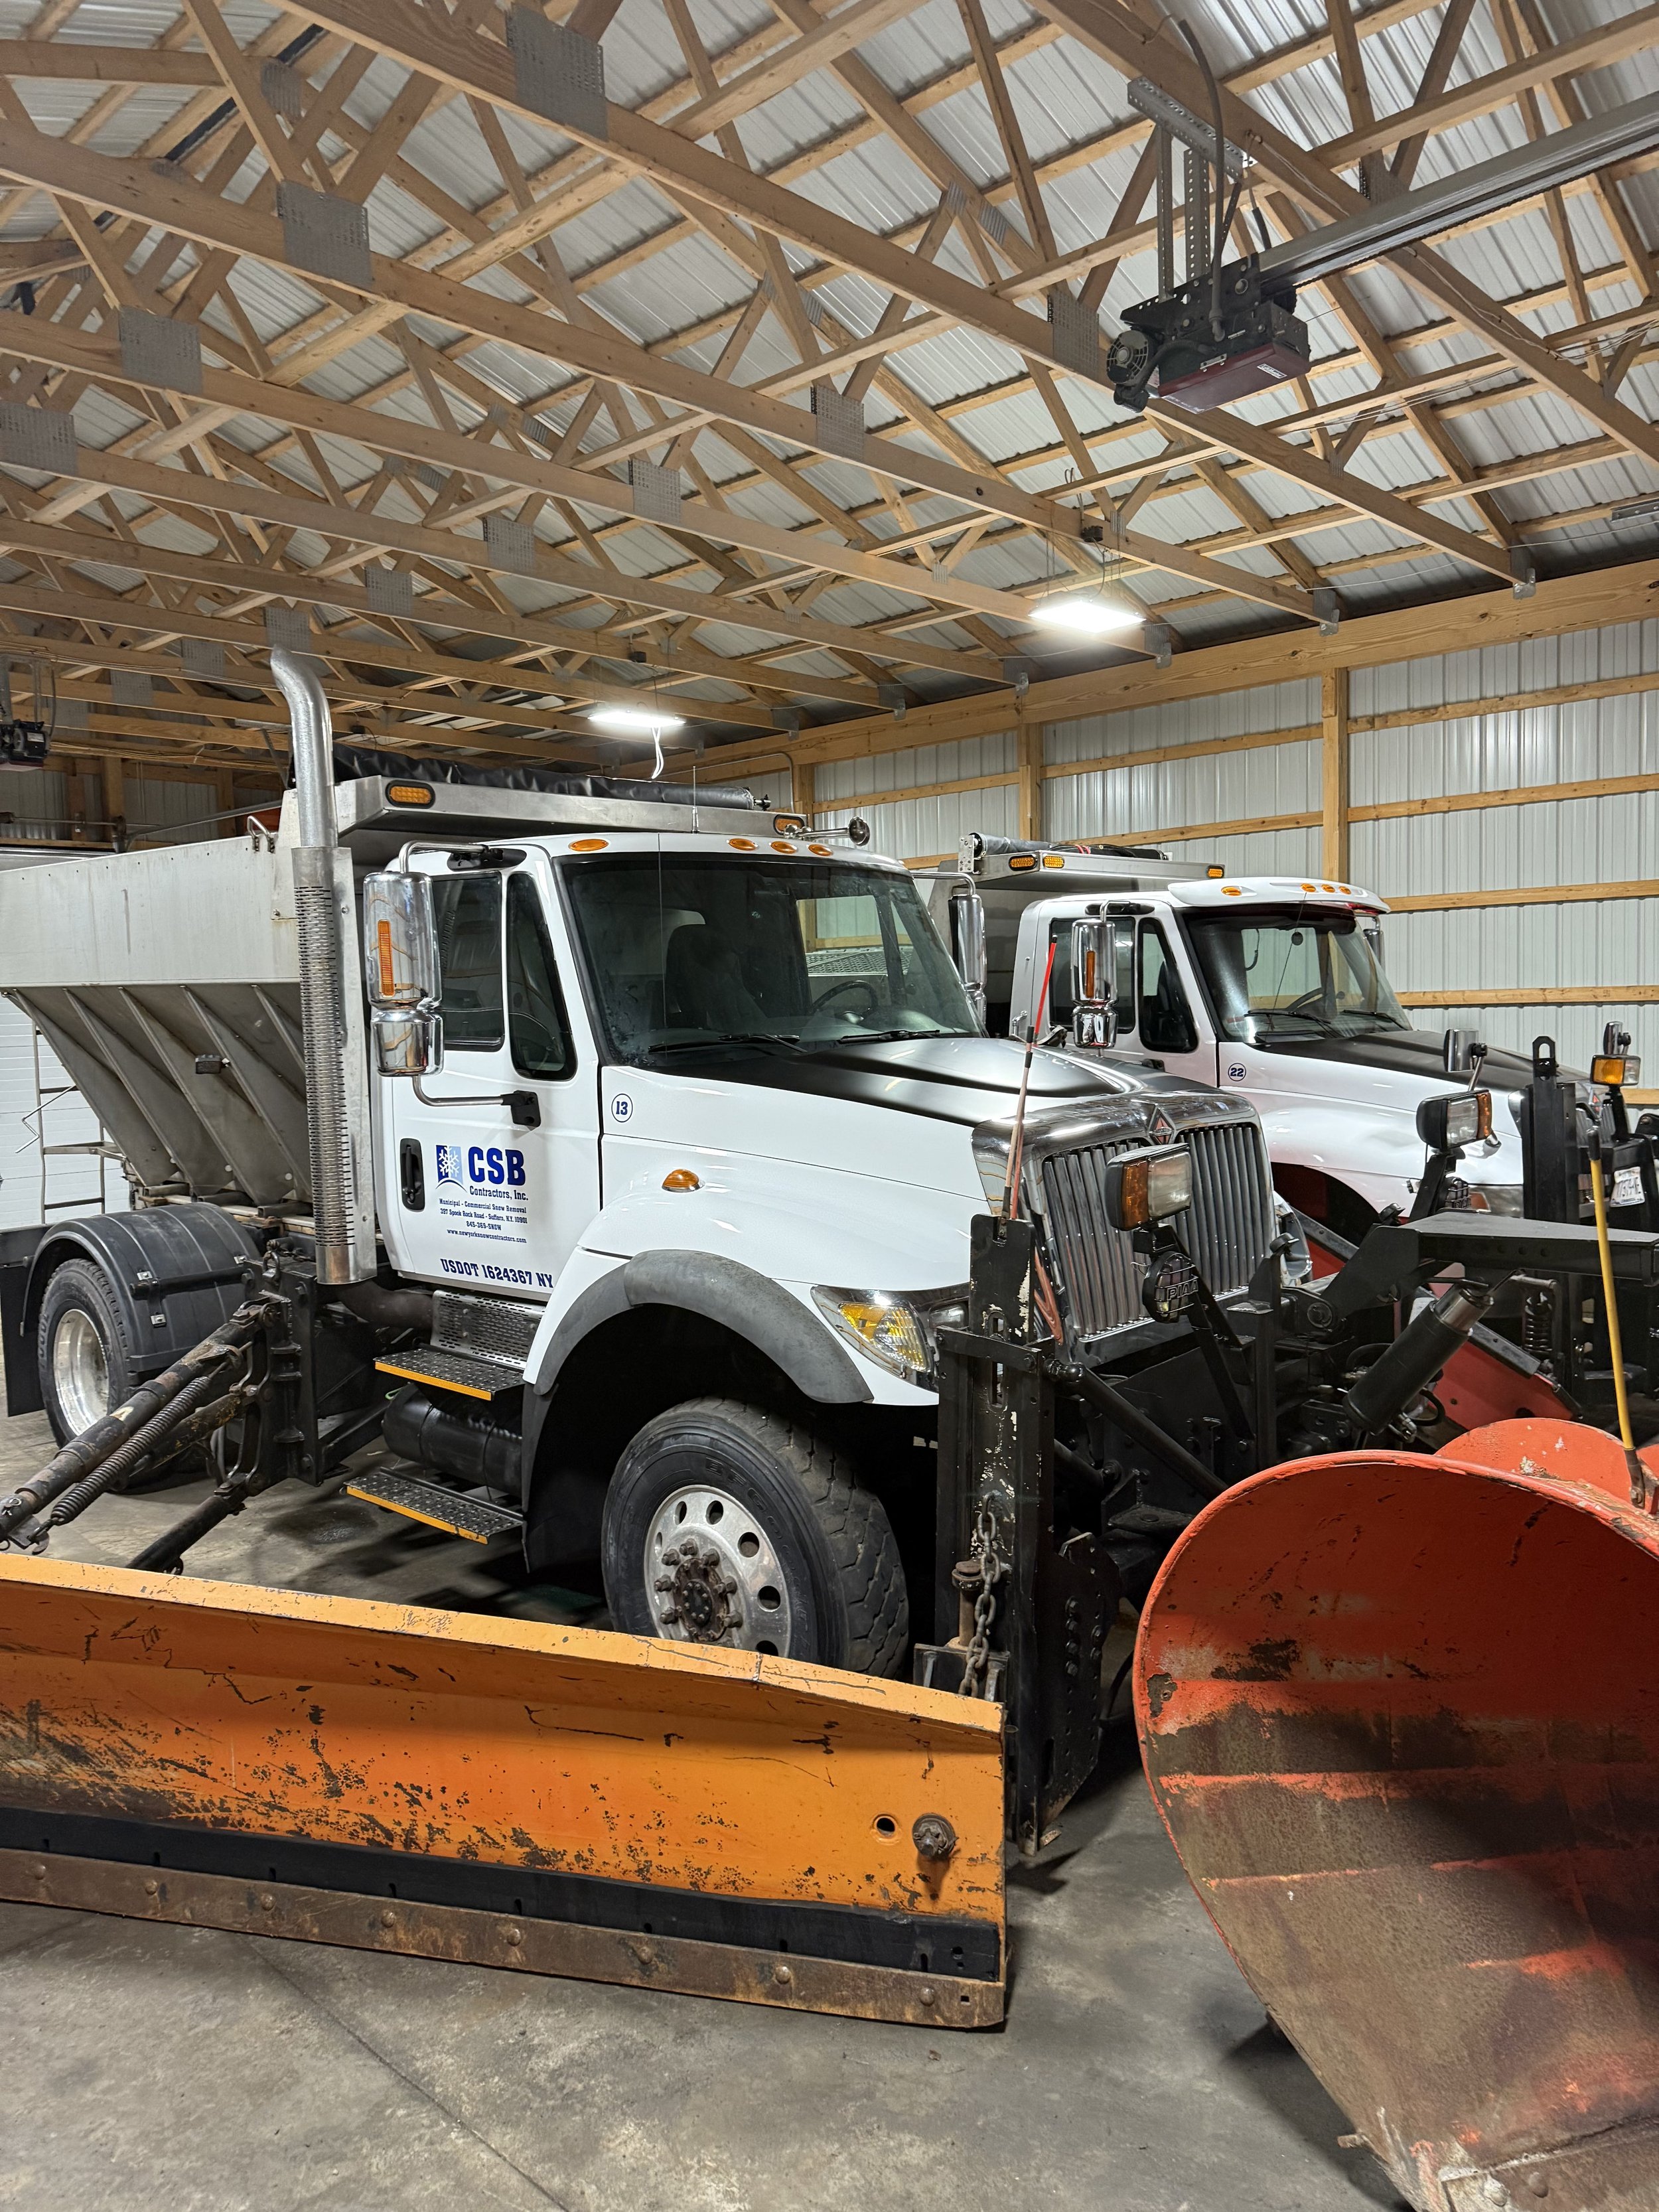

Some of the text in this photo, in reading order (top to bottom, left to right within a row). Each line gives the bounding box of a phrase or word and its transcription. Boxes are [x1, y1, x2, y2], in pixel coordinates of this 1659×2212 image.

[1230, 1067, 1244, 1077] 22
[616, 1101, 628, 1116] 13
[468, 1146, 526, 1186] CSB
[469, 1185, 529, 1201] Contractors, Inc.
[439, 1198, 461, 1207] Municipal
[465, 1201, 491, 1210] Commercial
[506, 1205, 527, 1214] Removal
[440, 1258, 554, 1288] USDOT 1624367 NY
[1167, 1280, 1199, 1301] PIAA
